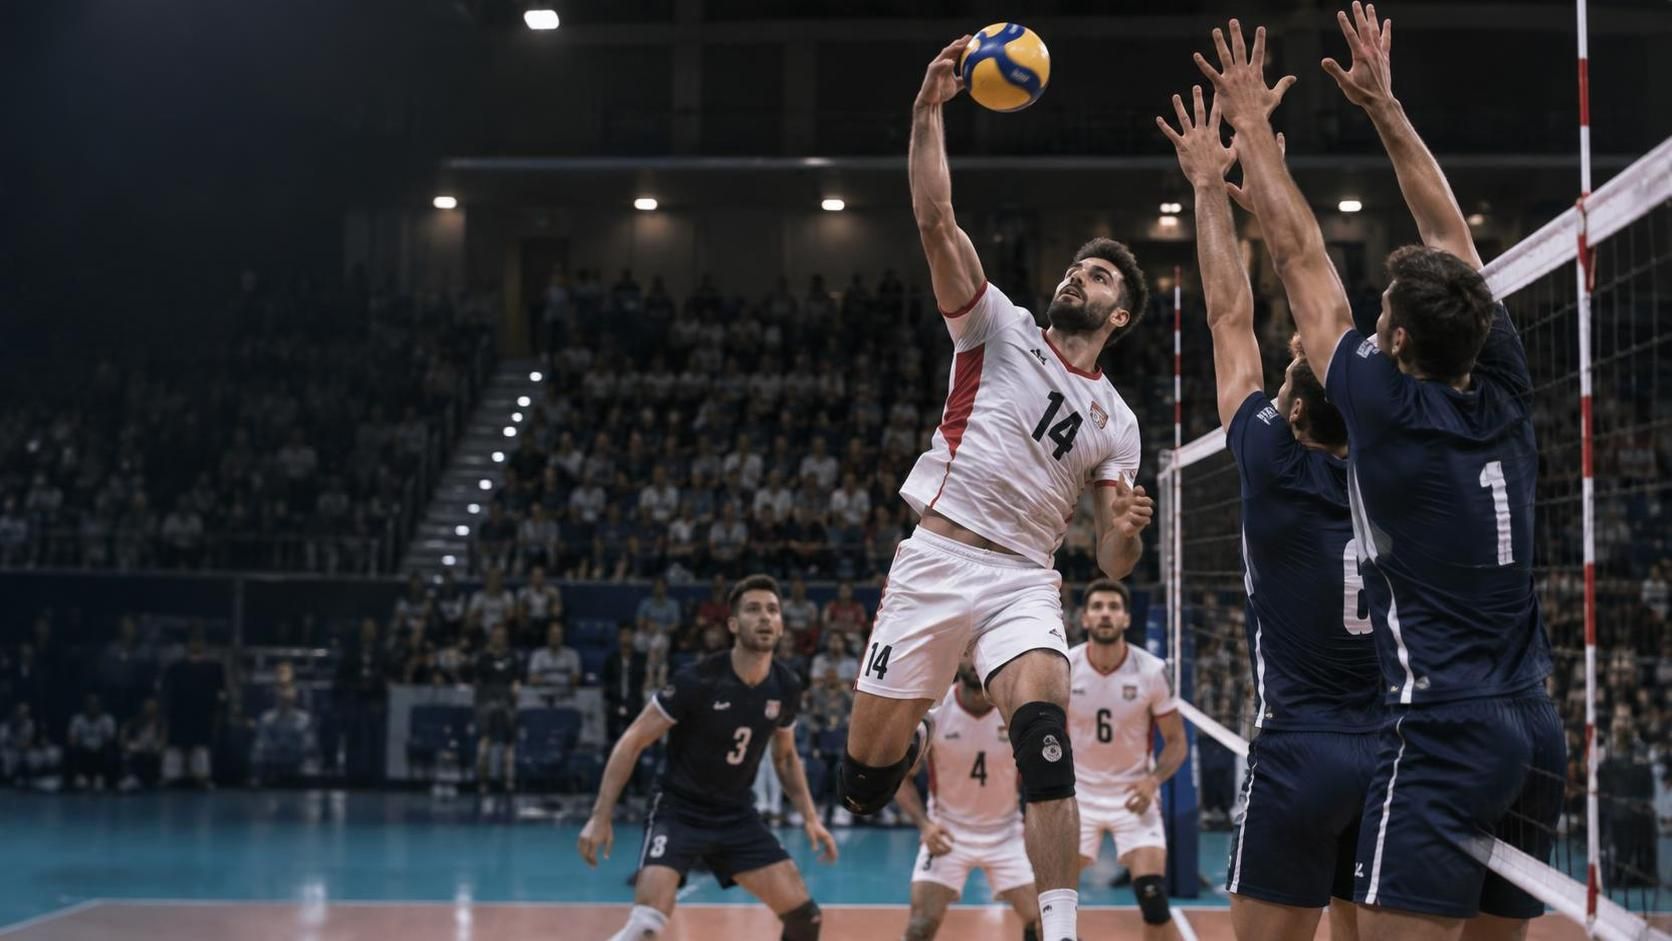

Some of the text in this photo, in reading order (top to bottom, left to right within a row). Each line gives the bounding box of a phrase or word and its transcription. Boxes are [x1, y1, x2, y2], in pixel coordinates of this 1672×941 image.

[1032, 391, 1083, 461] 14
[1479, 461, 1515, 566] 1
[865, 642, 893, 680] 14
[1096, 708, 1112, 744] 6
[726, 727, 752, 765] 3
[970, 751, 987, 787] 4
